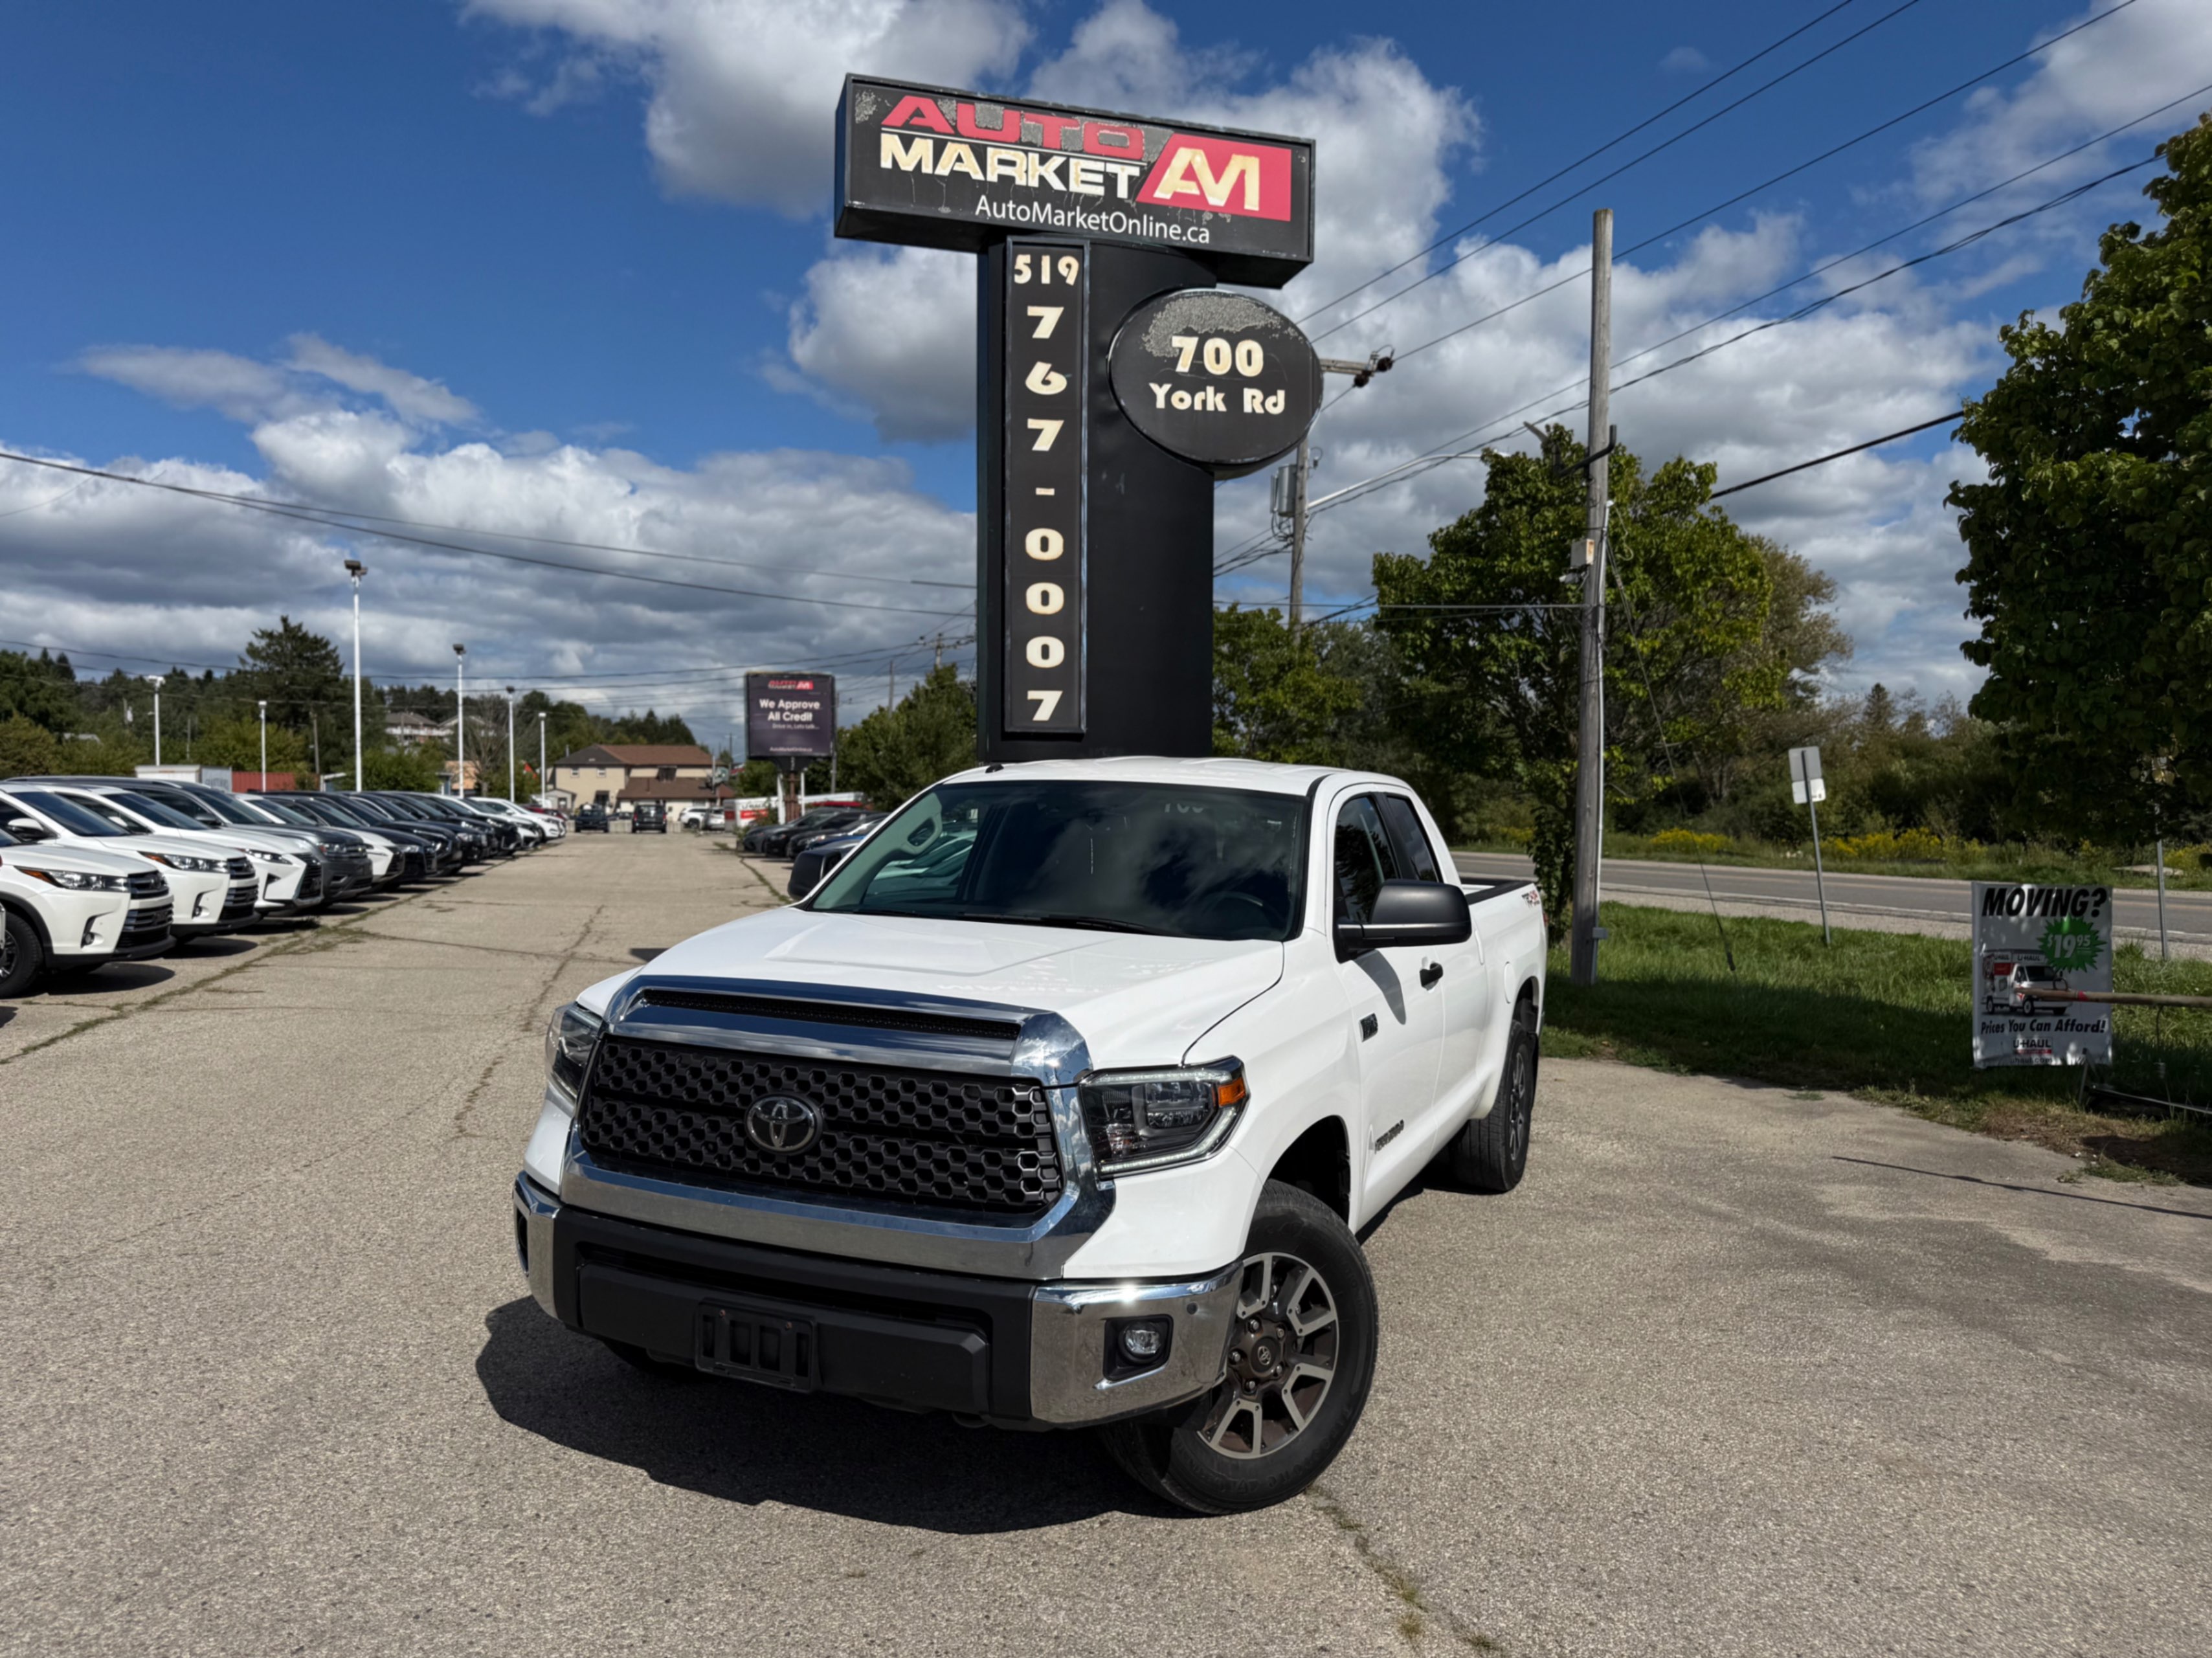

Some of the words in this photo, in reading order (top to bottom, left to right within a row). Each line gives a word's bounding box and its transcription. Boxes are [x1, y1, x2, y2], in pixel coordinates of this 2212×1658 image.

[881, 95, 1145, 160] AUTO
[880, 133, 1140, 199] MARKET
[1153, 146, 1260, 211] AM
[975, 195, 1210, 244] AutoMarketOnline.ca
[1014, 254, 1079, 286] 519
[1172, 335, 1264, 377] 700
[1148, 382, 1227, 412] York
[1243, 387, 1285, 415] Rd
[759, 699, 776, 708] We
[778, 699, 821, 711] Approve
[768, 711, 781, 721] All
[782, 711, 813, 721] Credit
[1982, 888, 2106, 918] MOVING?
[1980, 1020, 2005, 1035] Prices
[2008, 1019, 2026, 1033] You
[2029, 1019, 2051, 1032] Can
[2055, 1019, 2106, 1034] Afford!
